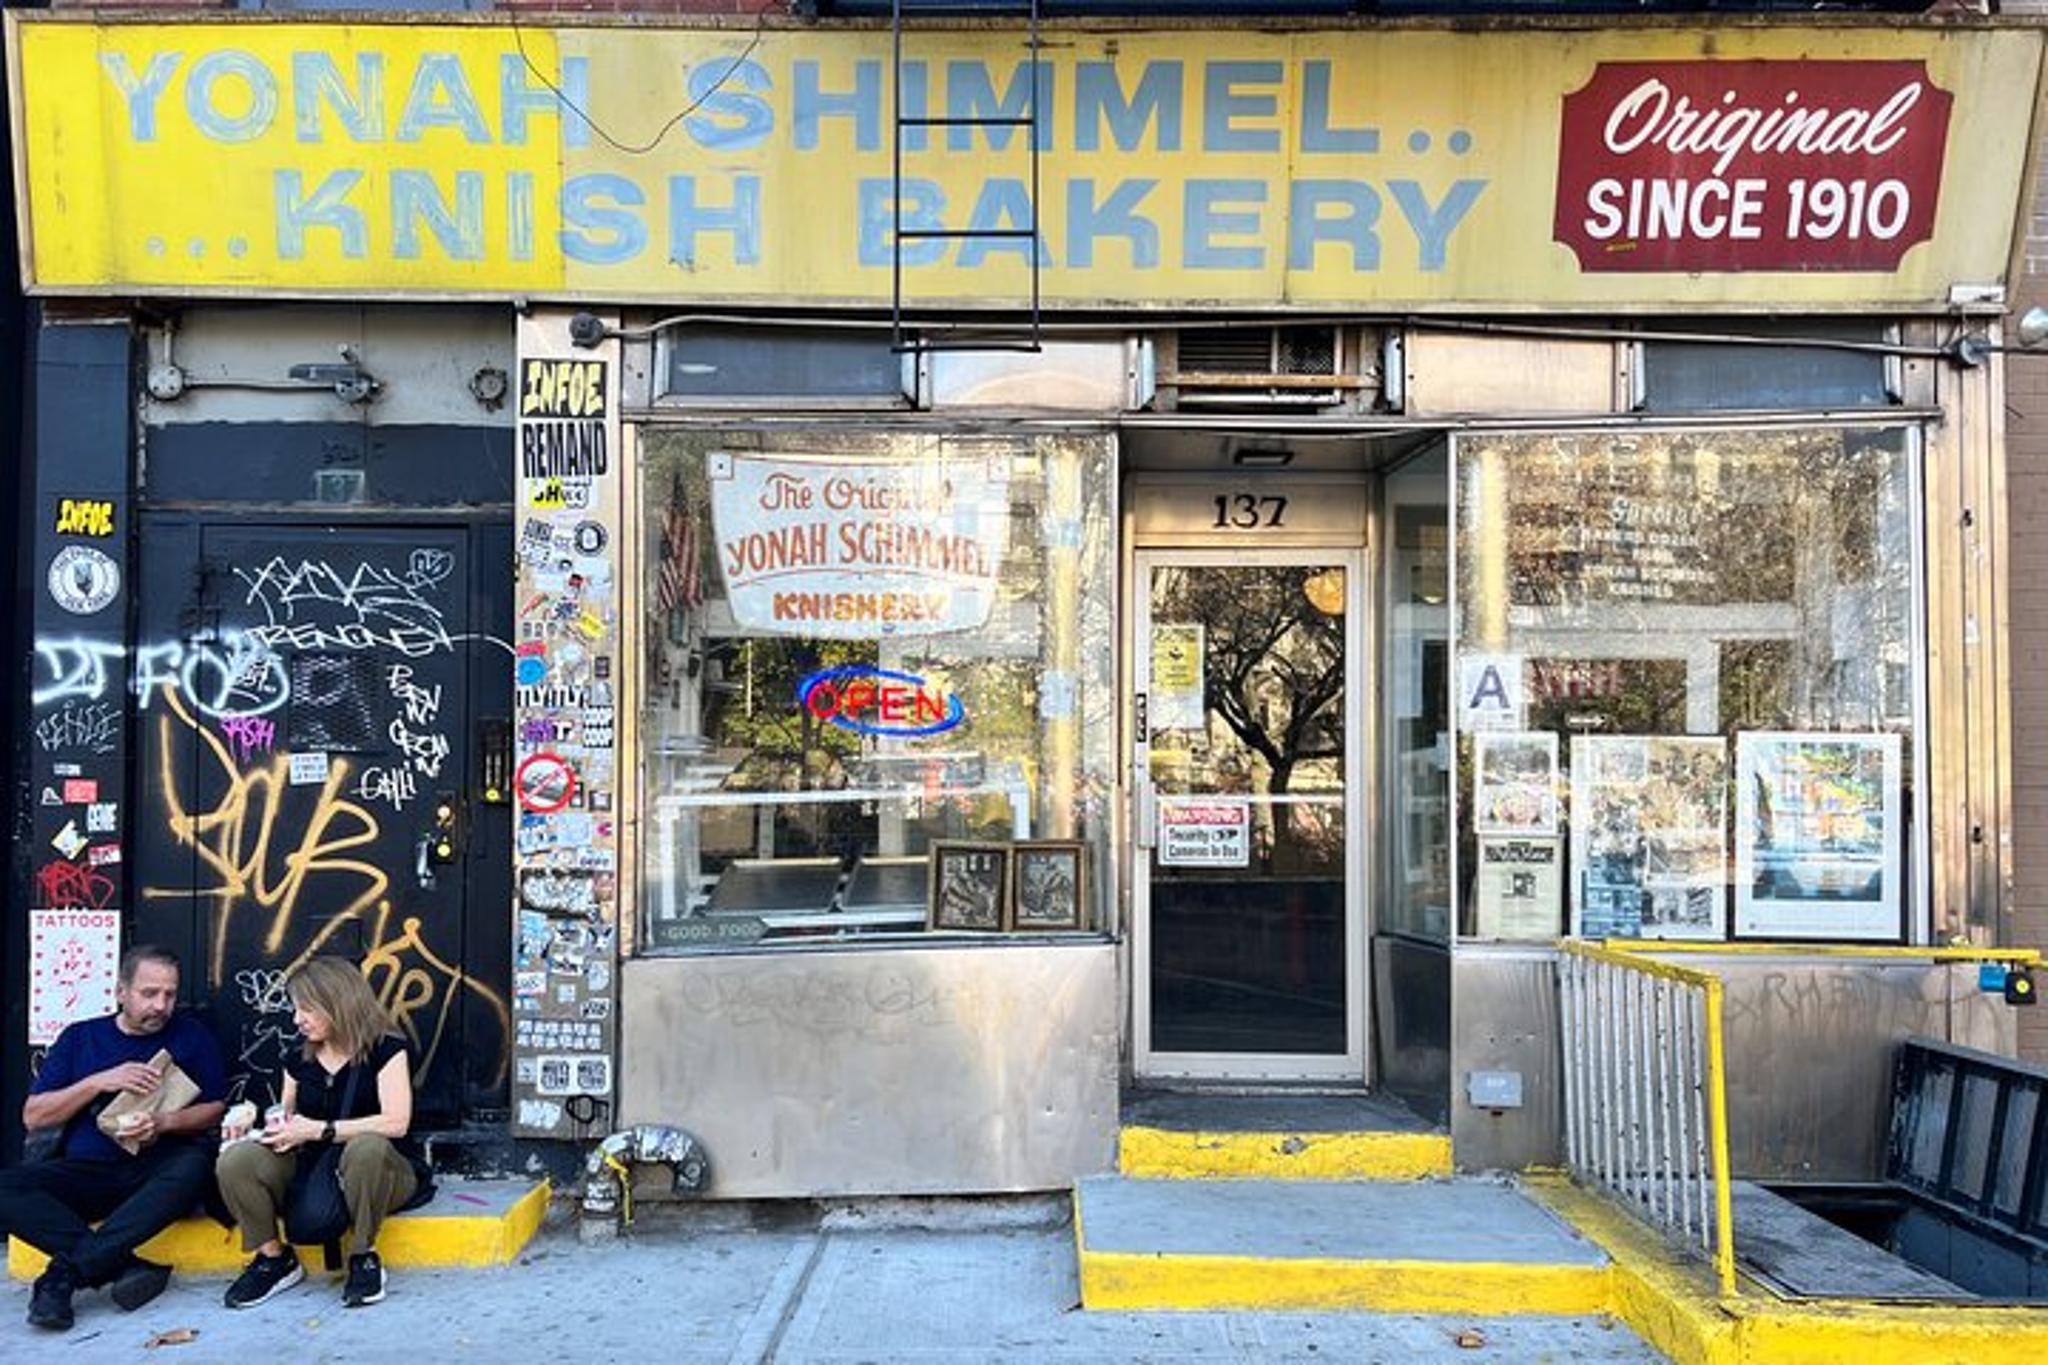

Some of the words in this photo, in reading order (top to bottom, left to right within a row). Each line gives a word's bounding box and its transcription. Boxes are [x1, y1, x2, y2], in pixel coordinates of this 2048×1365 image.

[101, 48, 591, 149] YONAH
[1604, 77, 1923, 177] Original
[856, 178, 1489, 273] BAKERY
[1584, 178, 1767, 240] SINCE
[1786, 178, 1911, 240] 1910
[522, 421, 607, 478] REMAND
[759, 471, 815, 511] The
[823, 475, 954, 518] Origl
[1213, 493, 1289, 529] 137
[724, 522, 828, 578] YONAH
[806, 676, 948, 723] OPEN
[1469, 664, 1511, 709] A
[34, 914, 116, 928] TATTOOS
